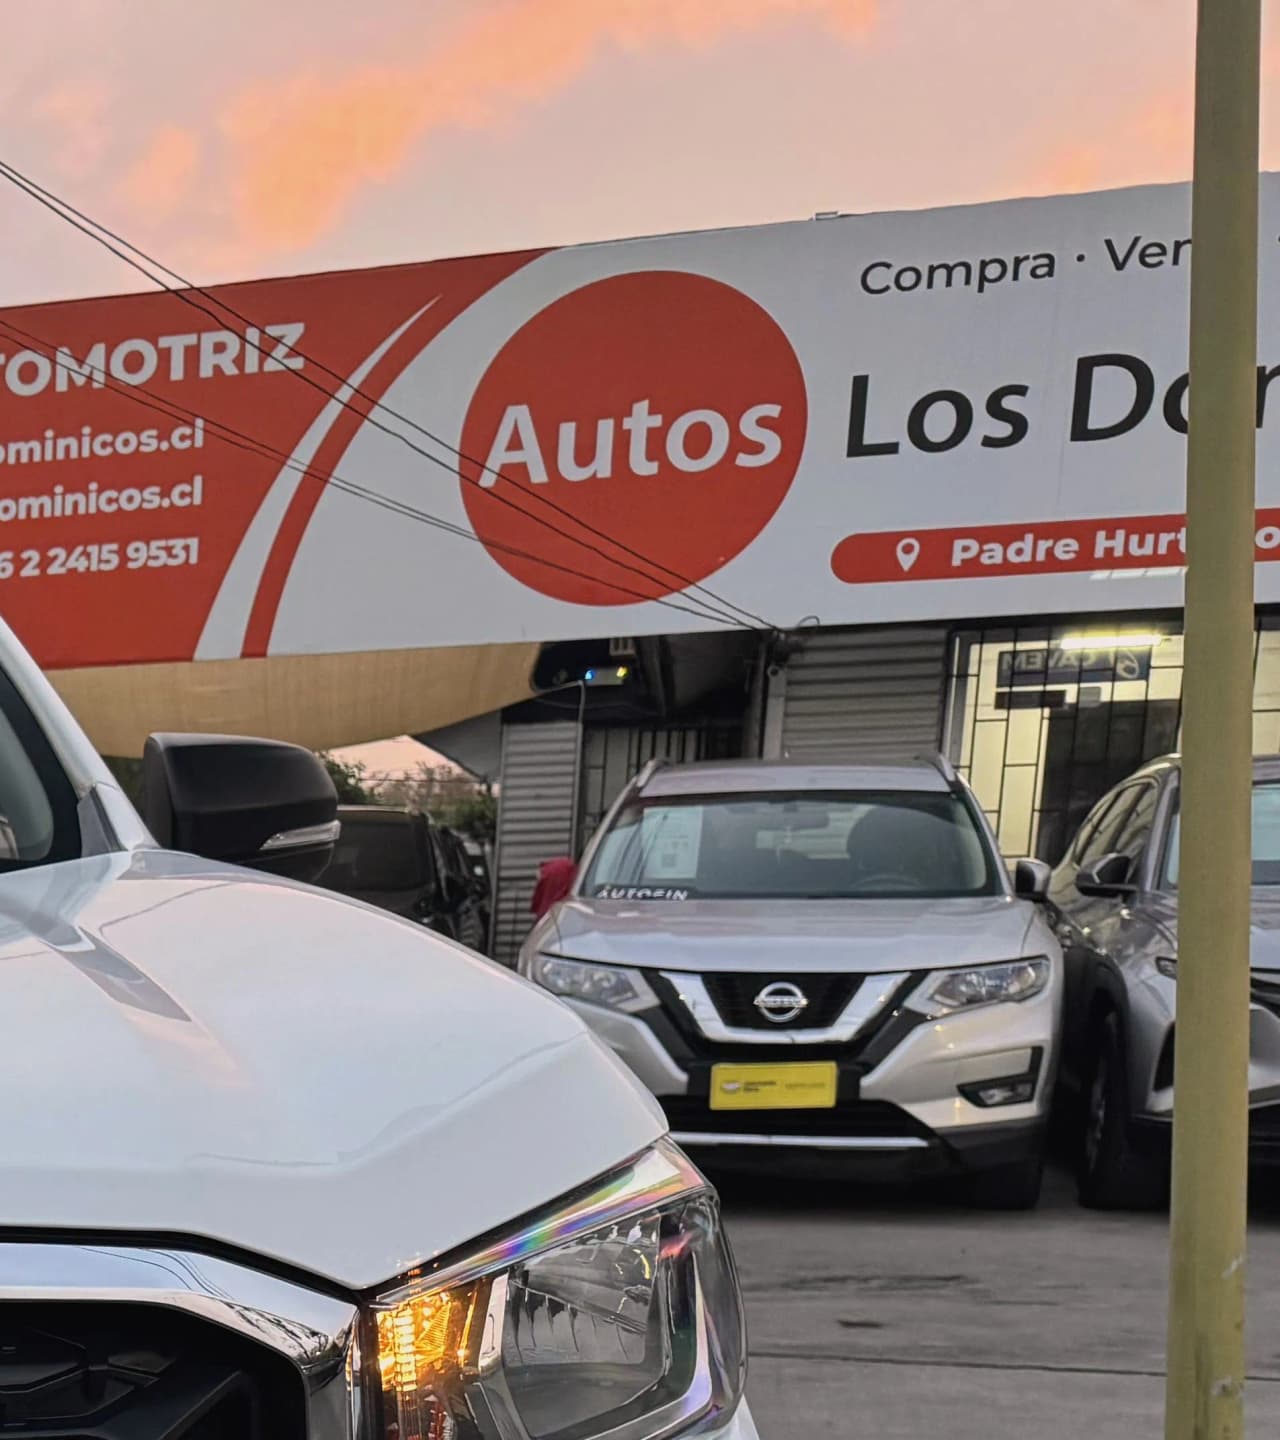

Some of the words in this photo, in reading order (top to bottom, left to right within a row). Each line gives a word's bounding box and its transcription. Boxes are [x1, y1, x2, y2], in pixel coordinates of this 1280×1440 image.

[858, 253, 1057, 297] Compra
[845, 372, 1030, 460] Los
[478, 397, 785, 488] Autos
[20, 550, 40, 577] 2
[47, 542, 119, 576] 2415
[127, 536, 200, 570] 9531
[950, 533, 1080, 569] Padre
